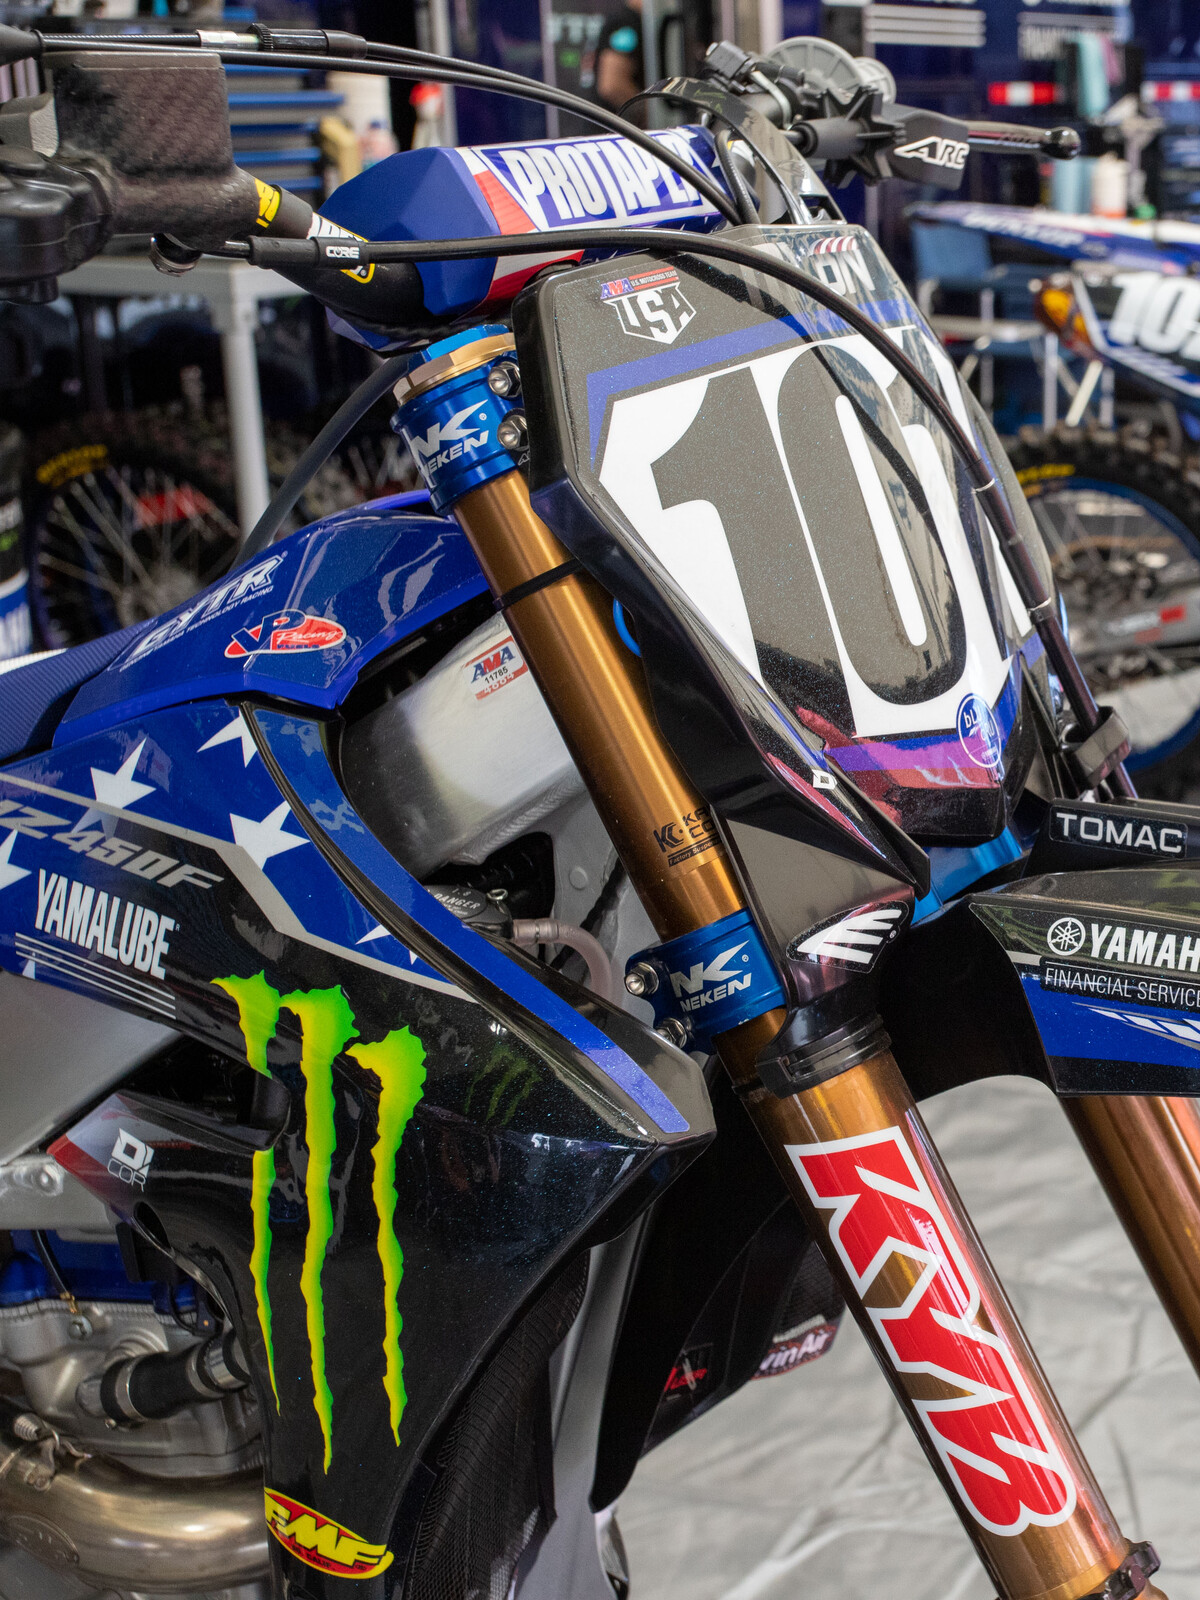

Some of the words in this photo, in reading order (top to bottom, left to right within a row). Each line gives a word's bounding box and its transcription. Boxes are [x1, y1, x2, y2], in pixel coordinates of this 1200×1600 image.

[894, 136, 970, 169] ARC
[326, 246, 360, 259] CORE
[601, 277, 634, 299] AMA
[665, 270, 678, 279] TEAM
[231, 609, 306, 653] VP
[277, 631, 342, 644] Racing
[471, 646, 516, 684] AMA
[485, 666, 508, 684] 11785
[1056, 812, 1183, 853] TOMAC
[434, 893, 480, 909] DANGER
[35, 868, 176, 981] YAMALUBE
[680, 973, 752, 1012] NEKEN
[1045, 968, 1132, 998] FINANCIAL
[784, 1126, 1077, 1536] KYB
[264, 1491, 387, 1568] FMF
